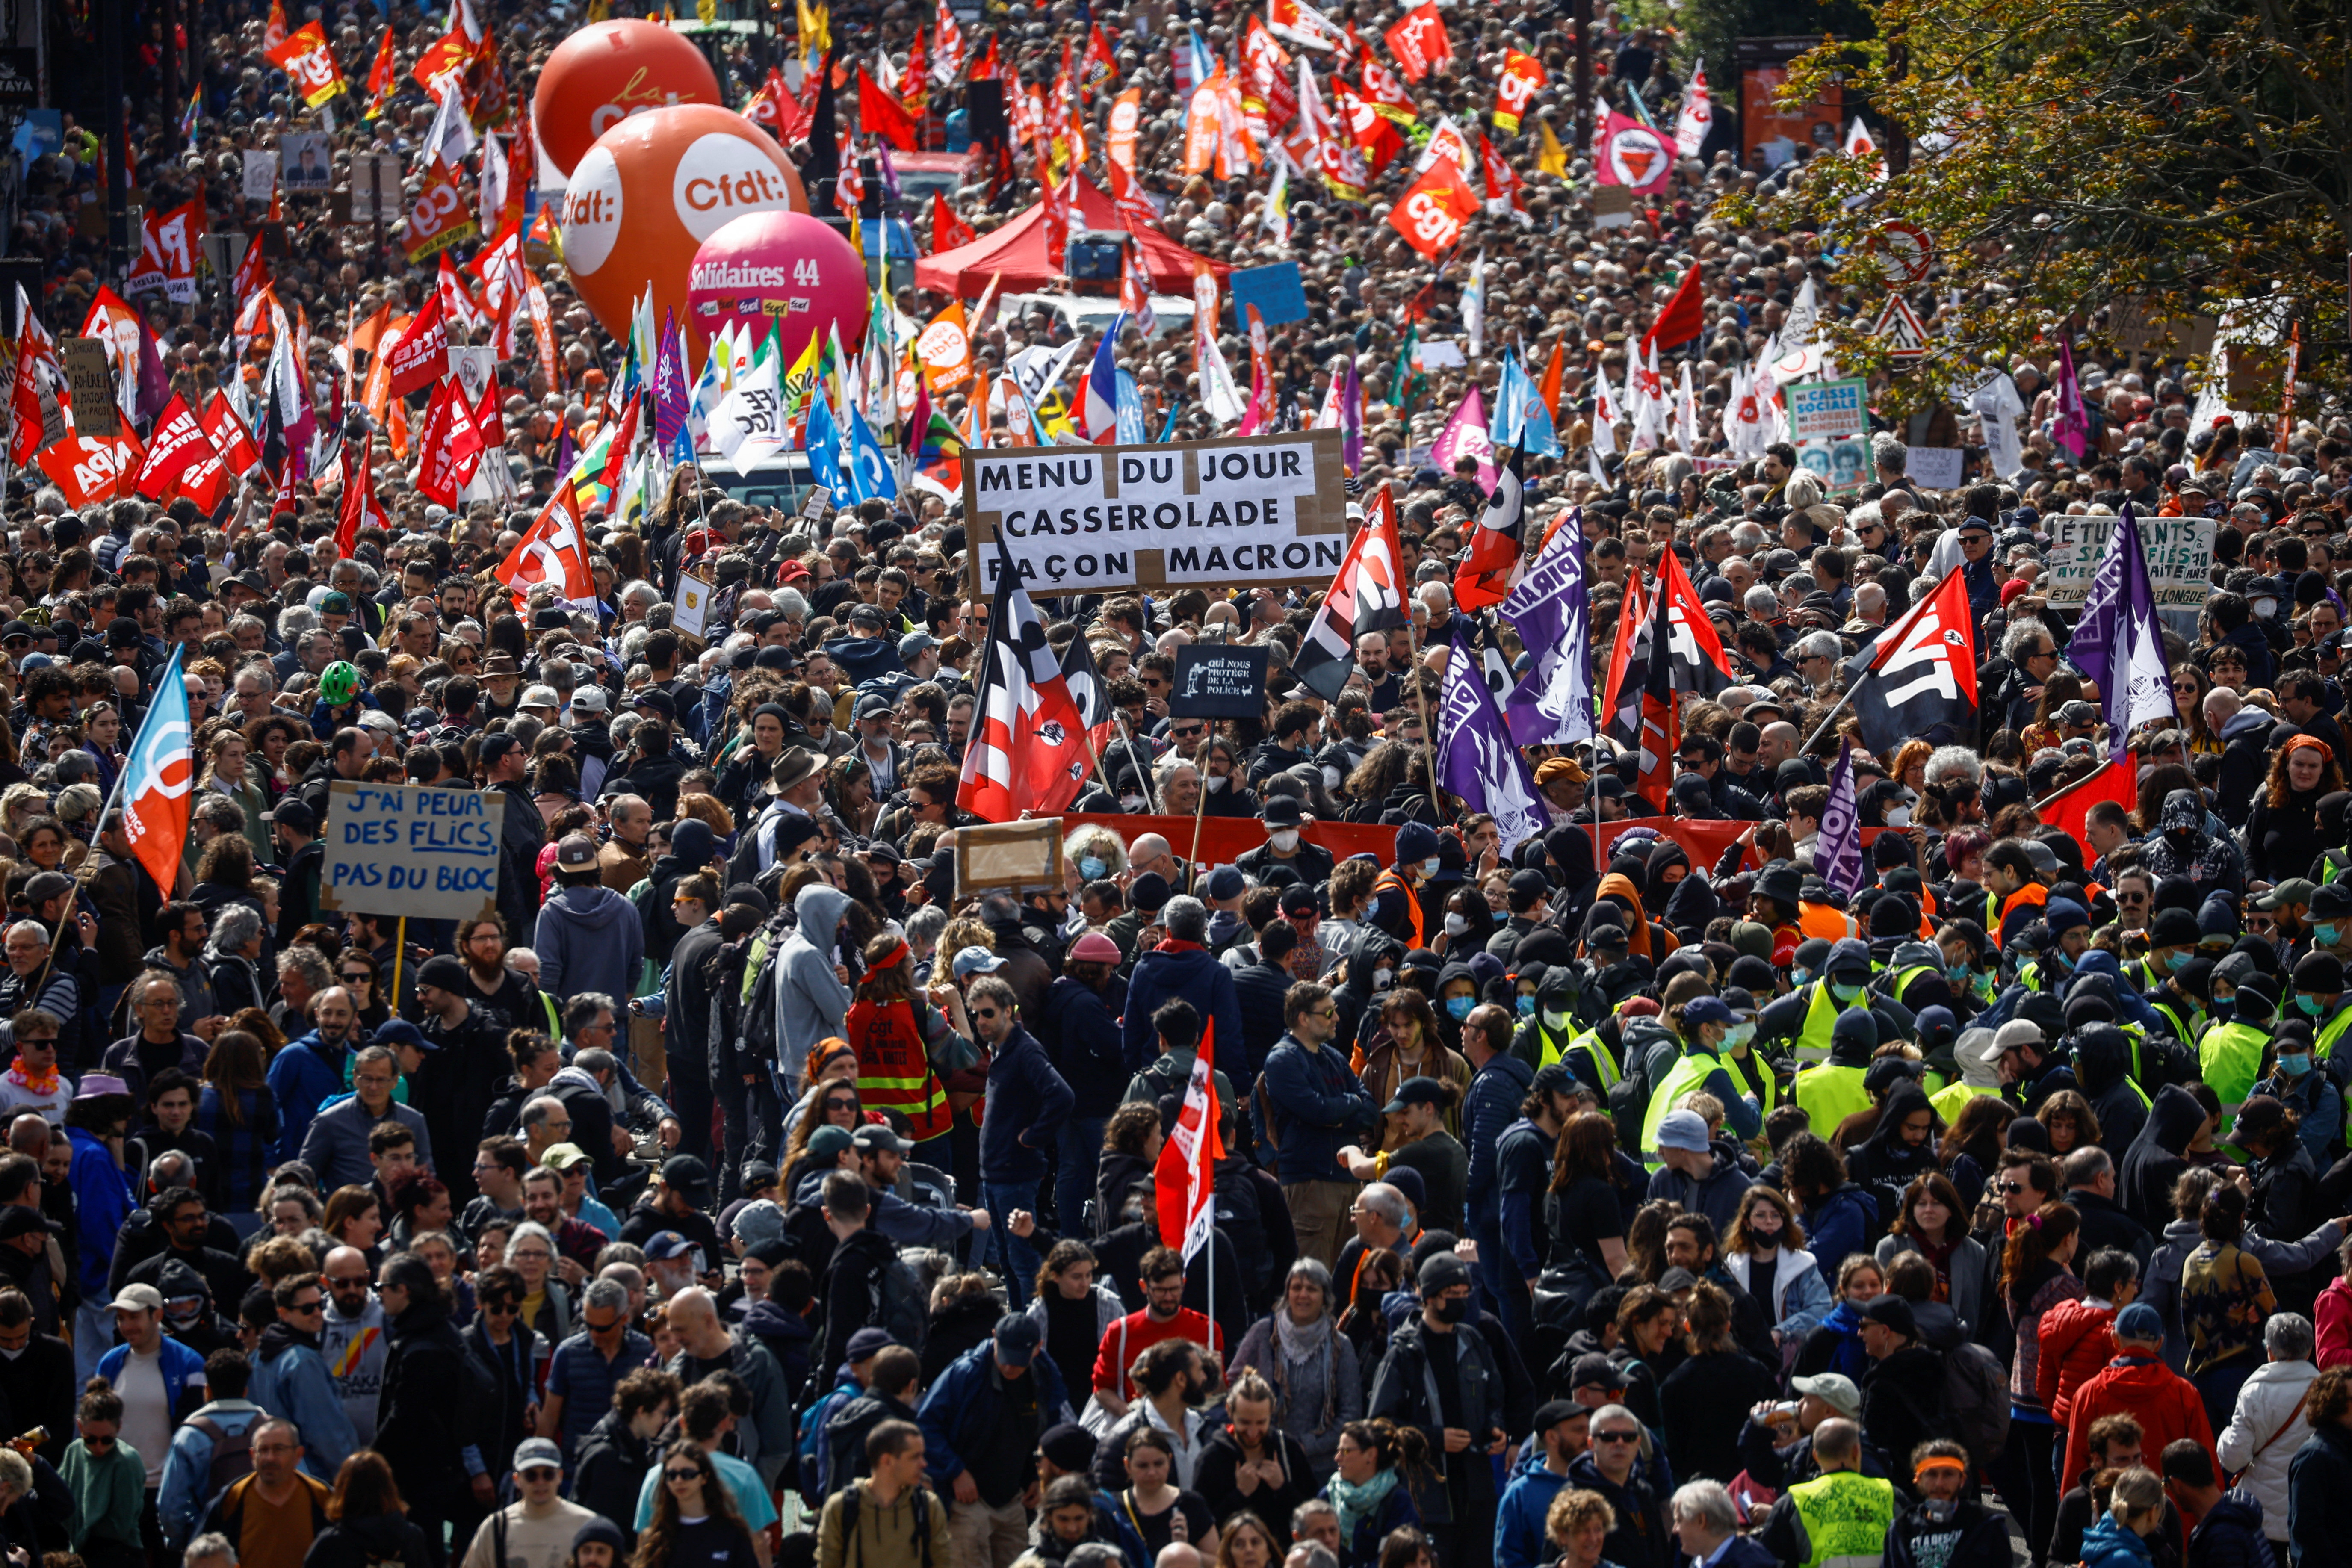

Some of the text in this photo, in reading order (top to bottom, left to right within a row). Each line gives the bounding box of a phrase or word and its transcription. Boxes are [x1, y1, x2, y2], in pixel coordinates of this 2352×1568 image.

[1407, 192, 1459, 247] cgt
[690, 258, 820, 291] Solidaires 44
[1808, 387, 1856, 399] CASSE
[1797, 399, 1857, 413] SOCIALE
[1799, 421, 1860, 432] MONDIALE
[981, 451, 1302, 492] MENU DU JOUR
[1006, 498, 1279, 537] CASSEROLADE
[988, 540, 1341, 583] FAÇON MACRON
[2192, 552, 2208, 567] 70
[1227, 660, 1250, 669] NOUS
[417, 793, 483, 816] PEUR
[345, 819, 399, 844] DES
[333, 862, 496, 892] PAS DU BLOC
[869, 1019, 893, 1037] cgt
